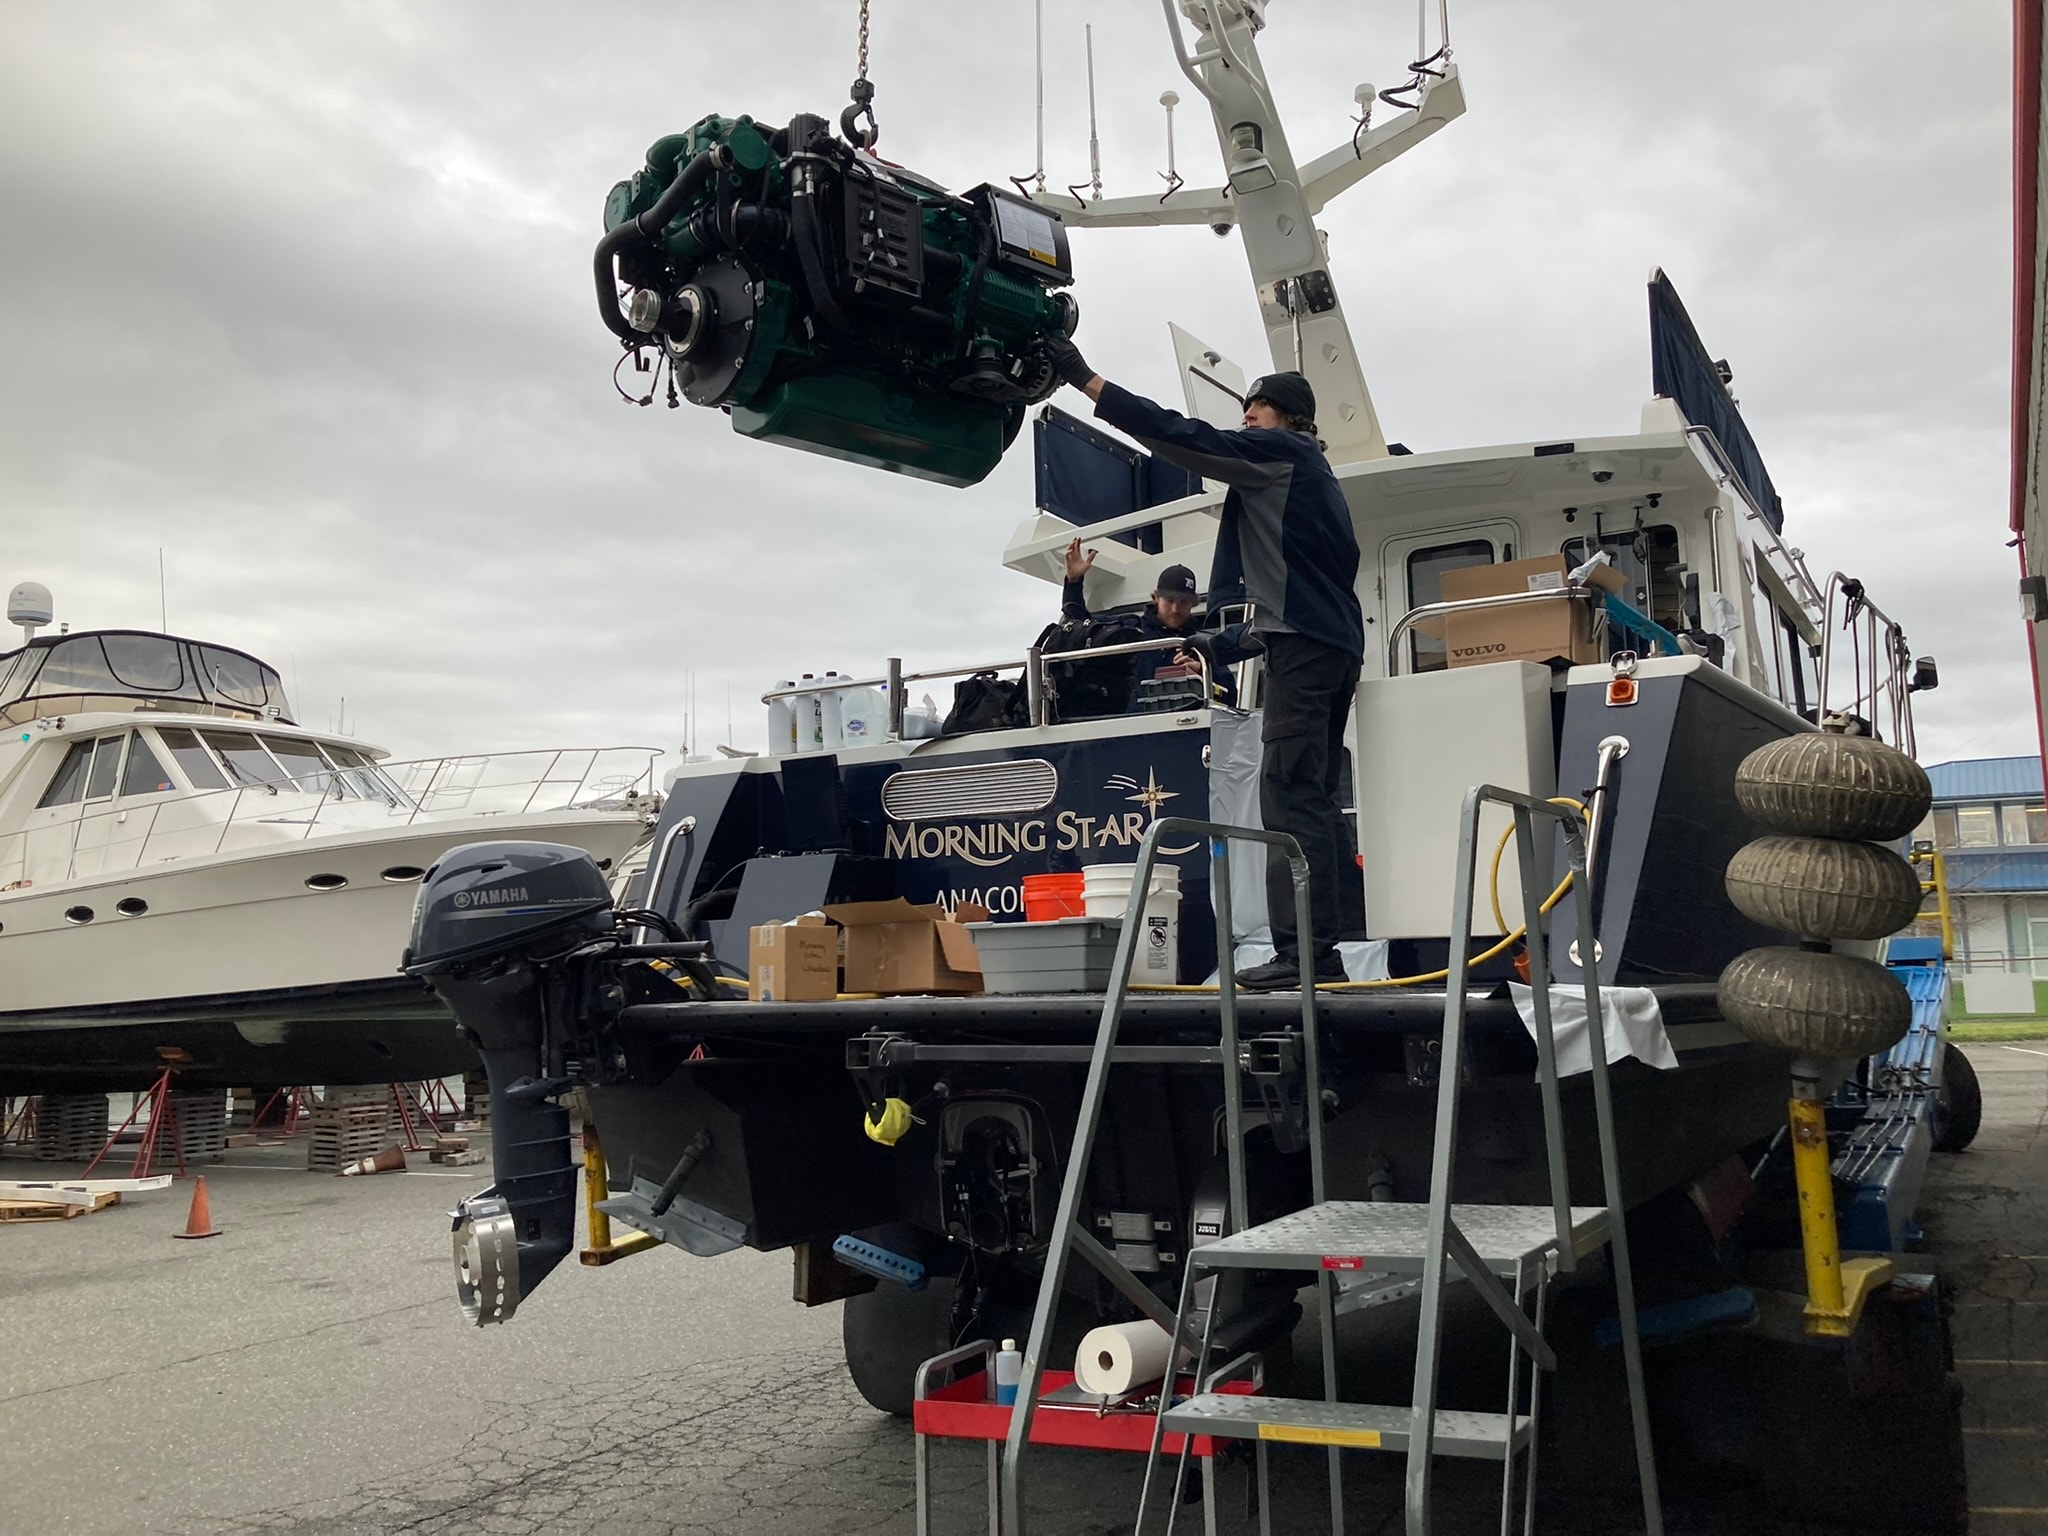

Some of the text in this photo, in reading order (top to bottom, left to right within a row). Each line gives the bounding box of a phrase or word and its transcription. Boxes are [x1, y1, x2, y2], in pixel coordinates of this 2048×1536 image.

[1452, 643, 1506, 657] VOLVO
[884, 811, 1200, 867] MORNING STAR
[470, 887, 529, 906] YAMAHA
[935, 885, 1025, 914] ANACO
